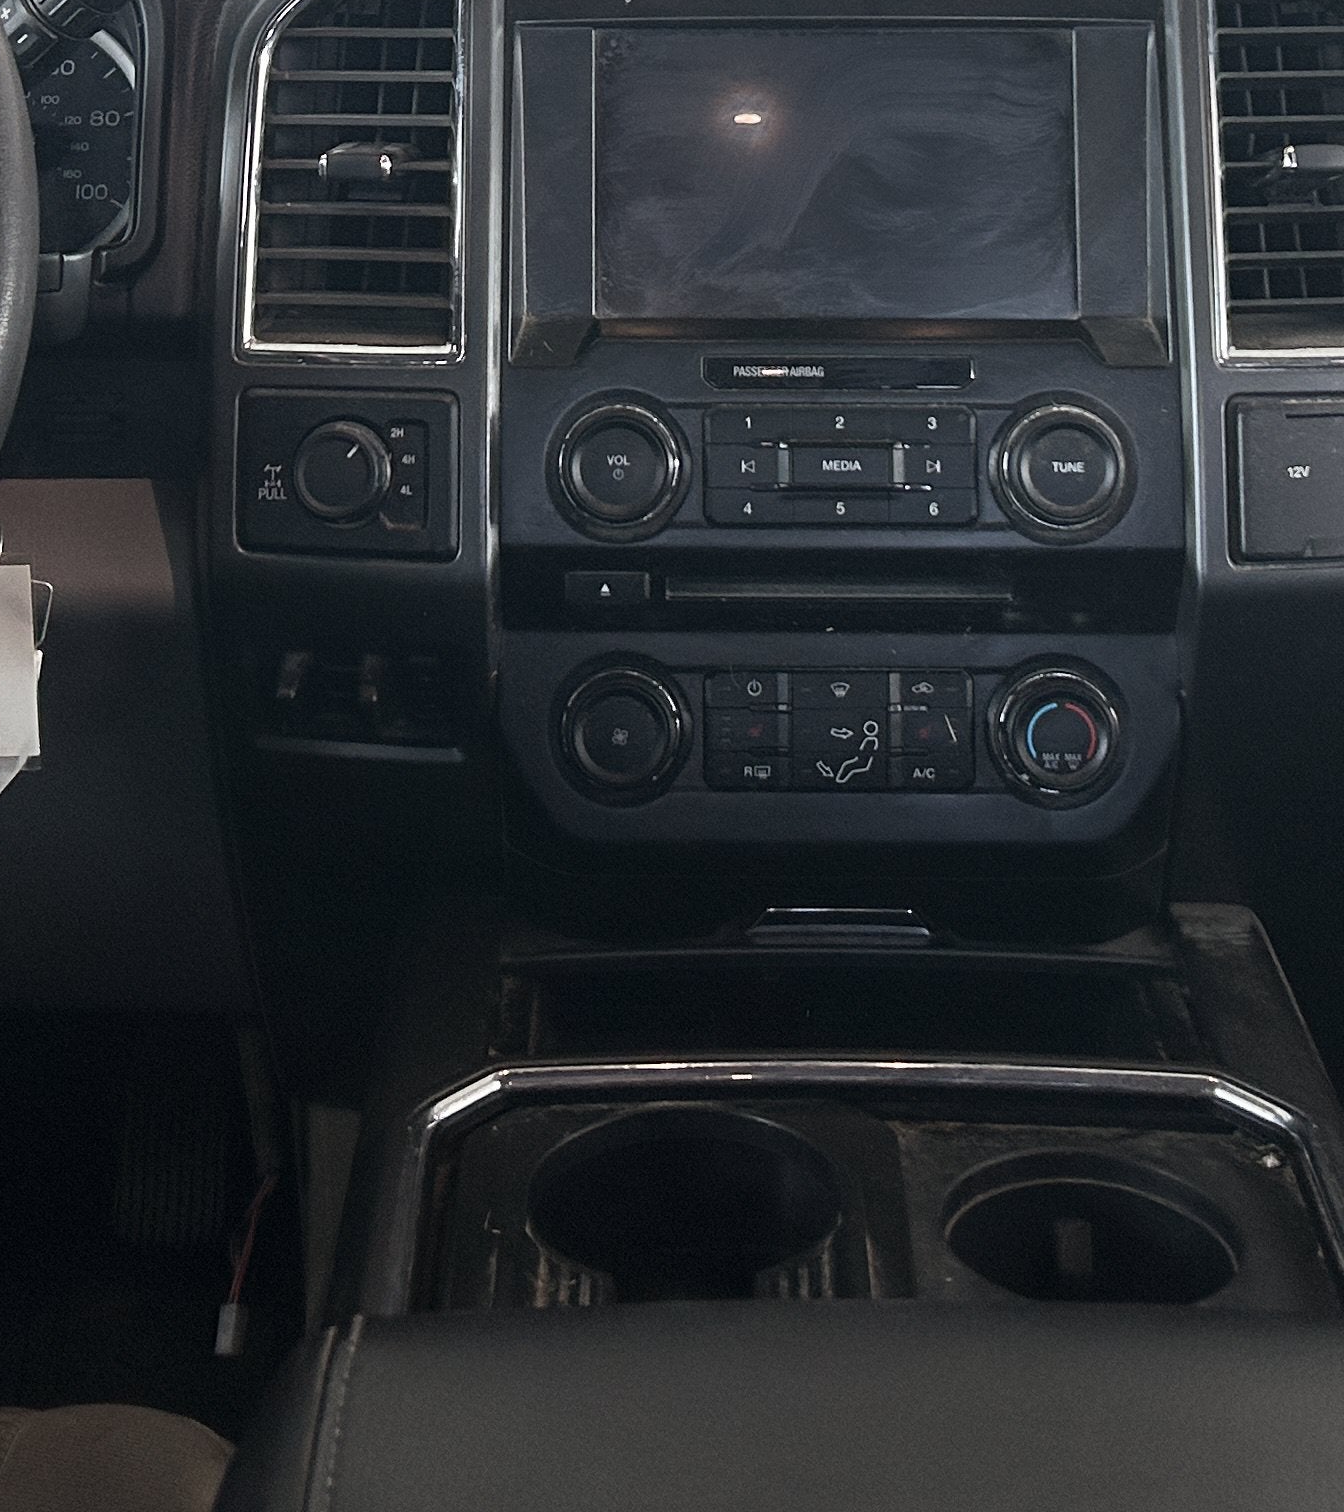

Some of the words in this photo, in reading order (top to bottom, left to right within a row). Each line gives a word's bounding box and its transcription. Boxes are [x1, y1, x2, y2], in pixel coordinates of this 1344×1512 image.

[40, 94, 60, 105] 100
[64, 116, 82, 125] 120
[89, 110, 120, 127] 80
[75, 184, 108, 200] 100
[789, 365, 825, 378] AIRBAG
[745, 416, 752, 429] 1
[835, 416, 845, 429] 2
[927, 416, 937, 429] 3
[390, 427, 404, 438] 2H
[402, 455, 416, 465] 4H
[606, 454, 631, 466] VOL
[822, 459, 862, 471] MEDIA
[1051, 461, 1085, 473] TUNE
[1287, 465, 1311, 479] 12V
[258, 488, 287, 500] PULL
[399, 485, 413, 496] 4L
[743, 502, 752, 515] 4
[836, 502, 845, 515] 5
[929, 502, 939, 516] 6
[913, 768, 935, 780] A/C
